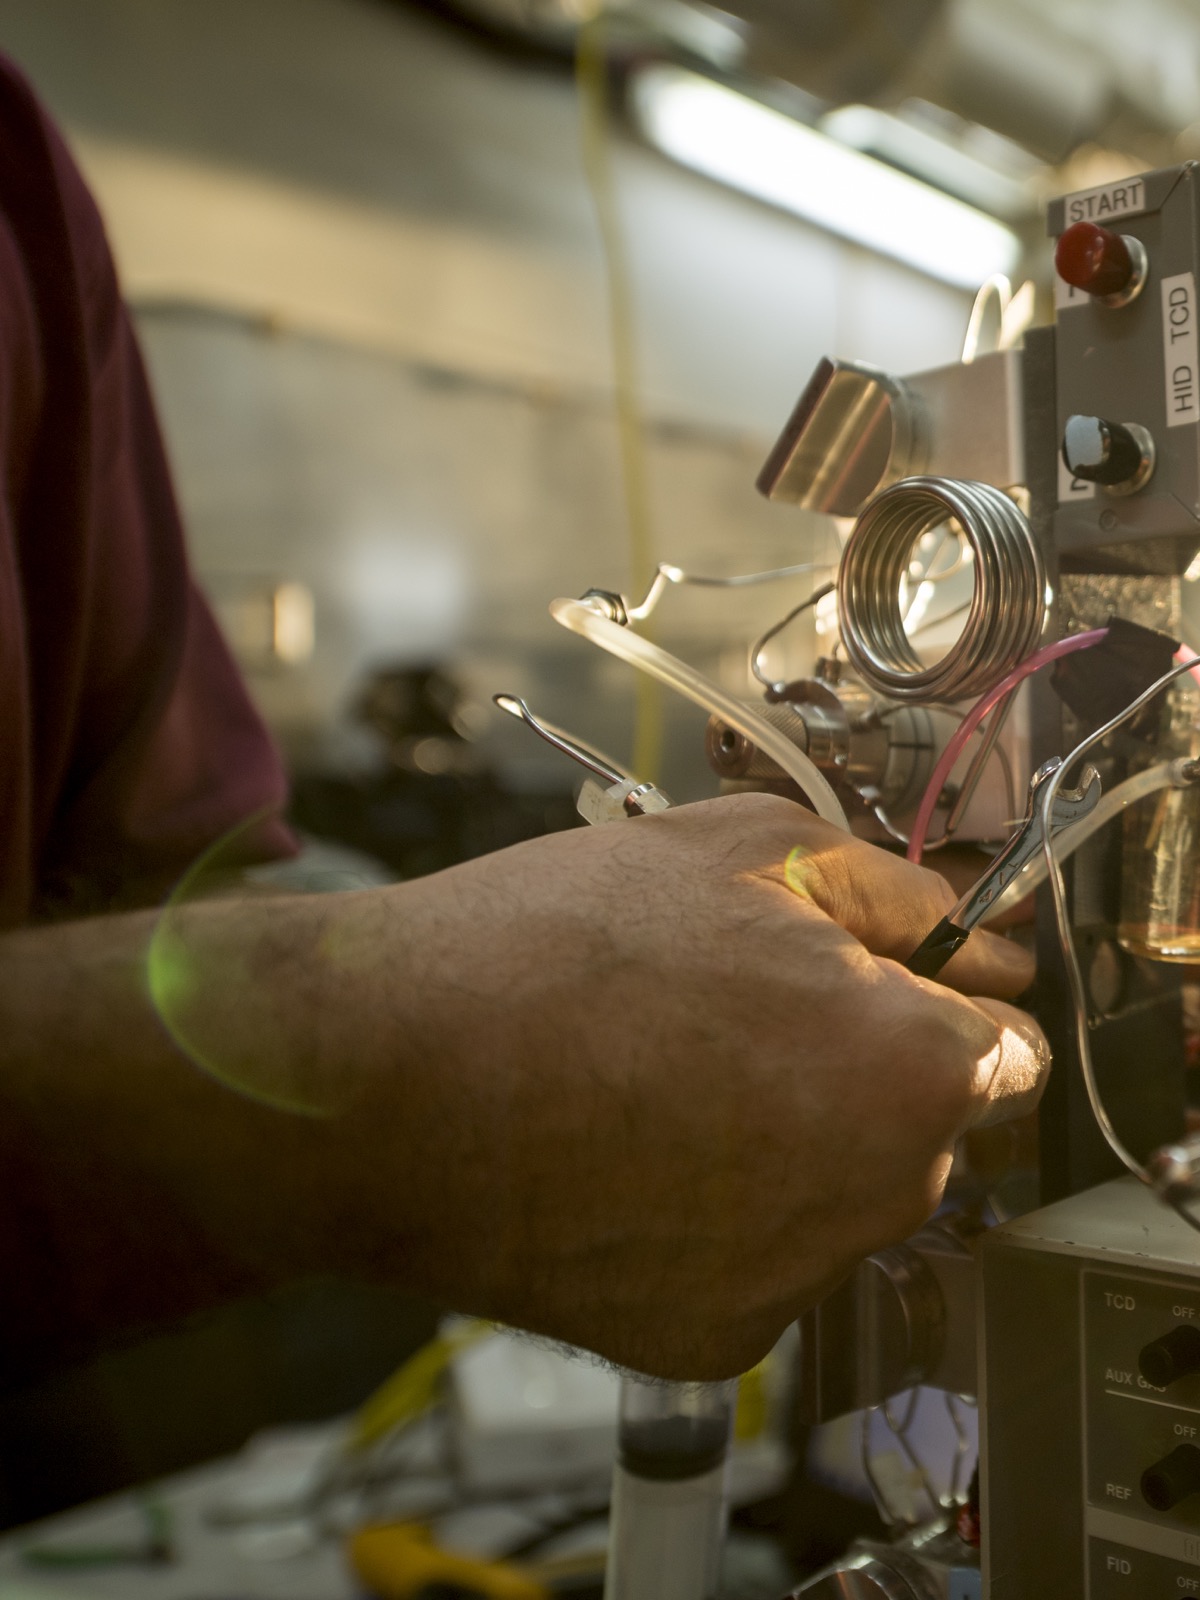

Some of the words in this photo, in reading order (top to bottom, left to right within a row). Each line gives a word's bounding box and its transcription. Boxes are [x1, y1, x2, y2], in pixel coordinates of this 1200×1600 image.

[1069, 183, 1143, 222] START
[1169, 286, 1190, 344] TCD
[1173, 364, 1194, 413] HID
[1104, 1293, 1136, 1311] TCD
[1172, 1305, 1196, 1319] OFF
[1105, 1368, 1133, 1386] AUX
[1173, 1424, 1197, 1438] OFF
[1106, 1484, 1132, 1500] REF
[1106, 1556, 1131, 1575] FID
[1176, 1575, 1200, 1591] OFF
